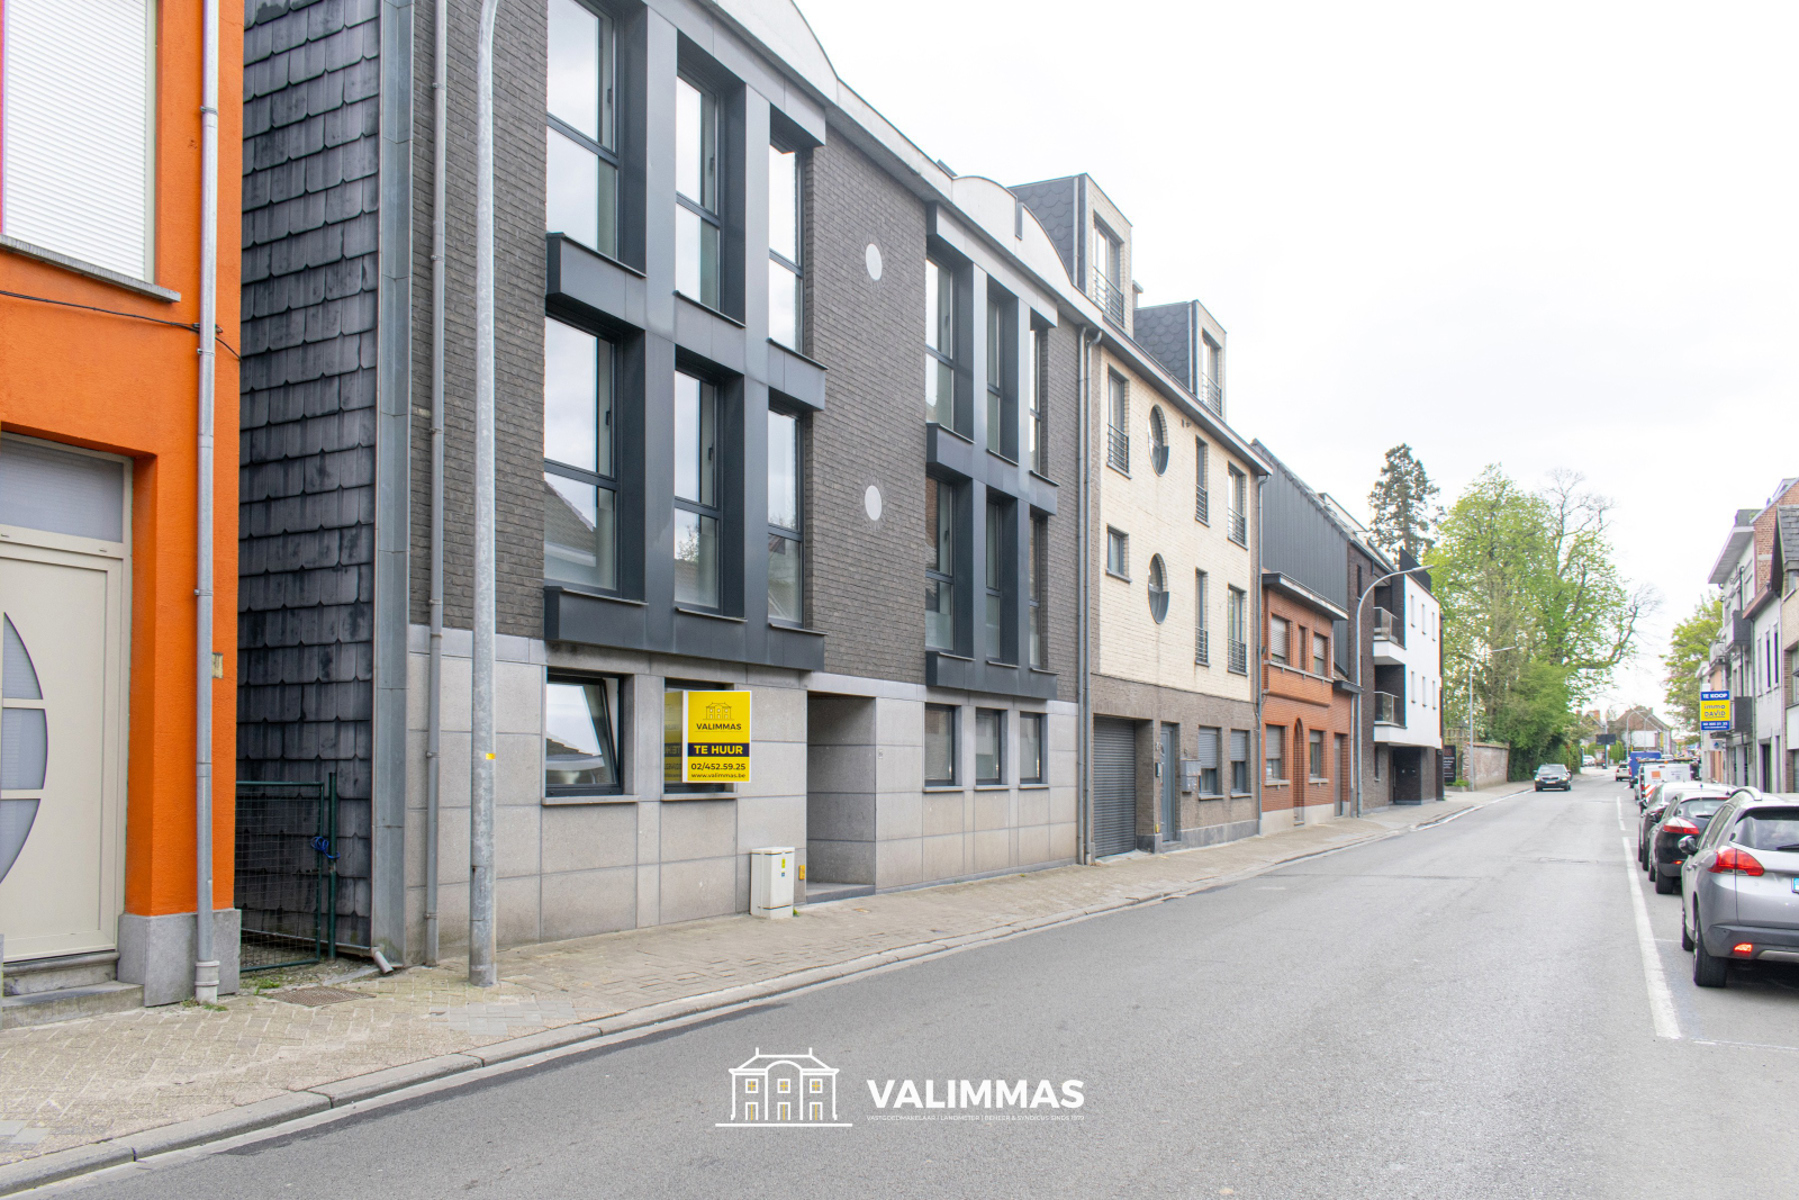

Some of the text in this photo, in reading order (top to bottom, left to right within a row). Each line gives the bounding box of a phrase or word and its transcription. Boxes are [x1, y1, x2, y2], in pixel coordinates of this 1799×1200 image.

[693, 745, 743, 755] TE HUUR
[690, 762, 746, 771] 02/452.59.25
